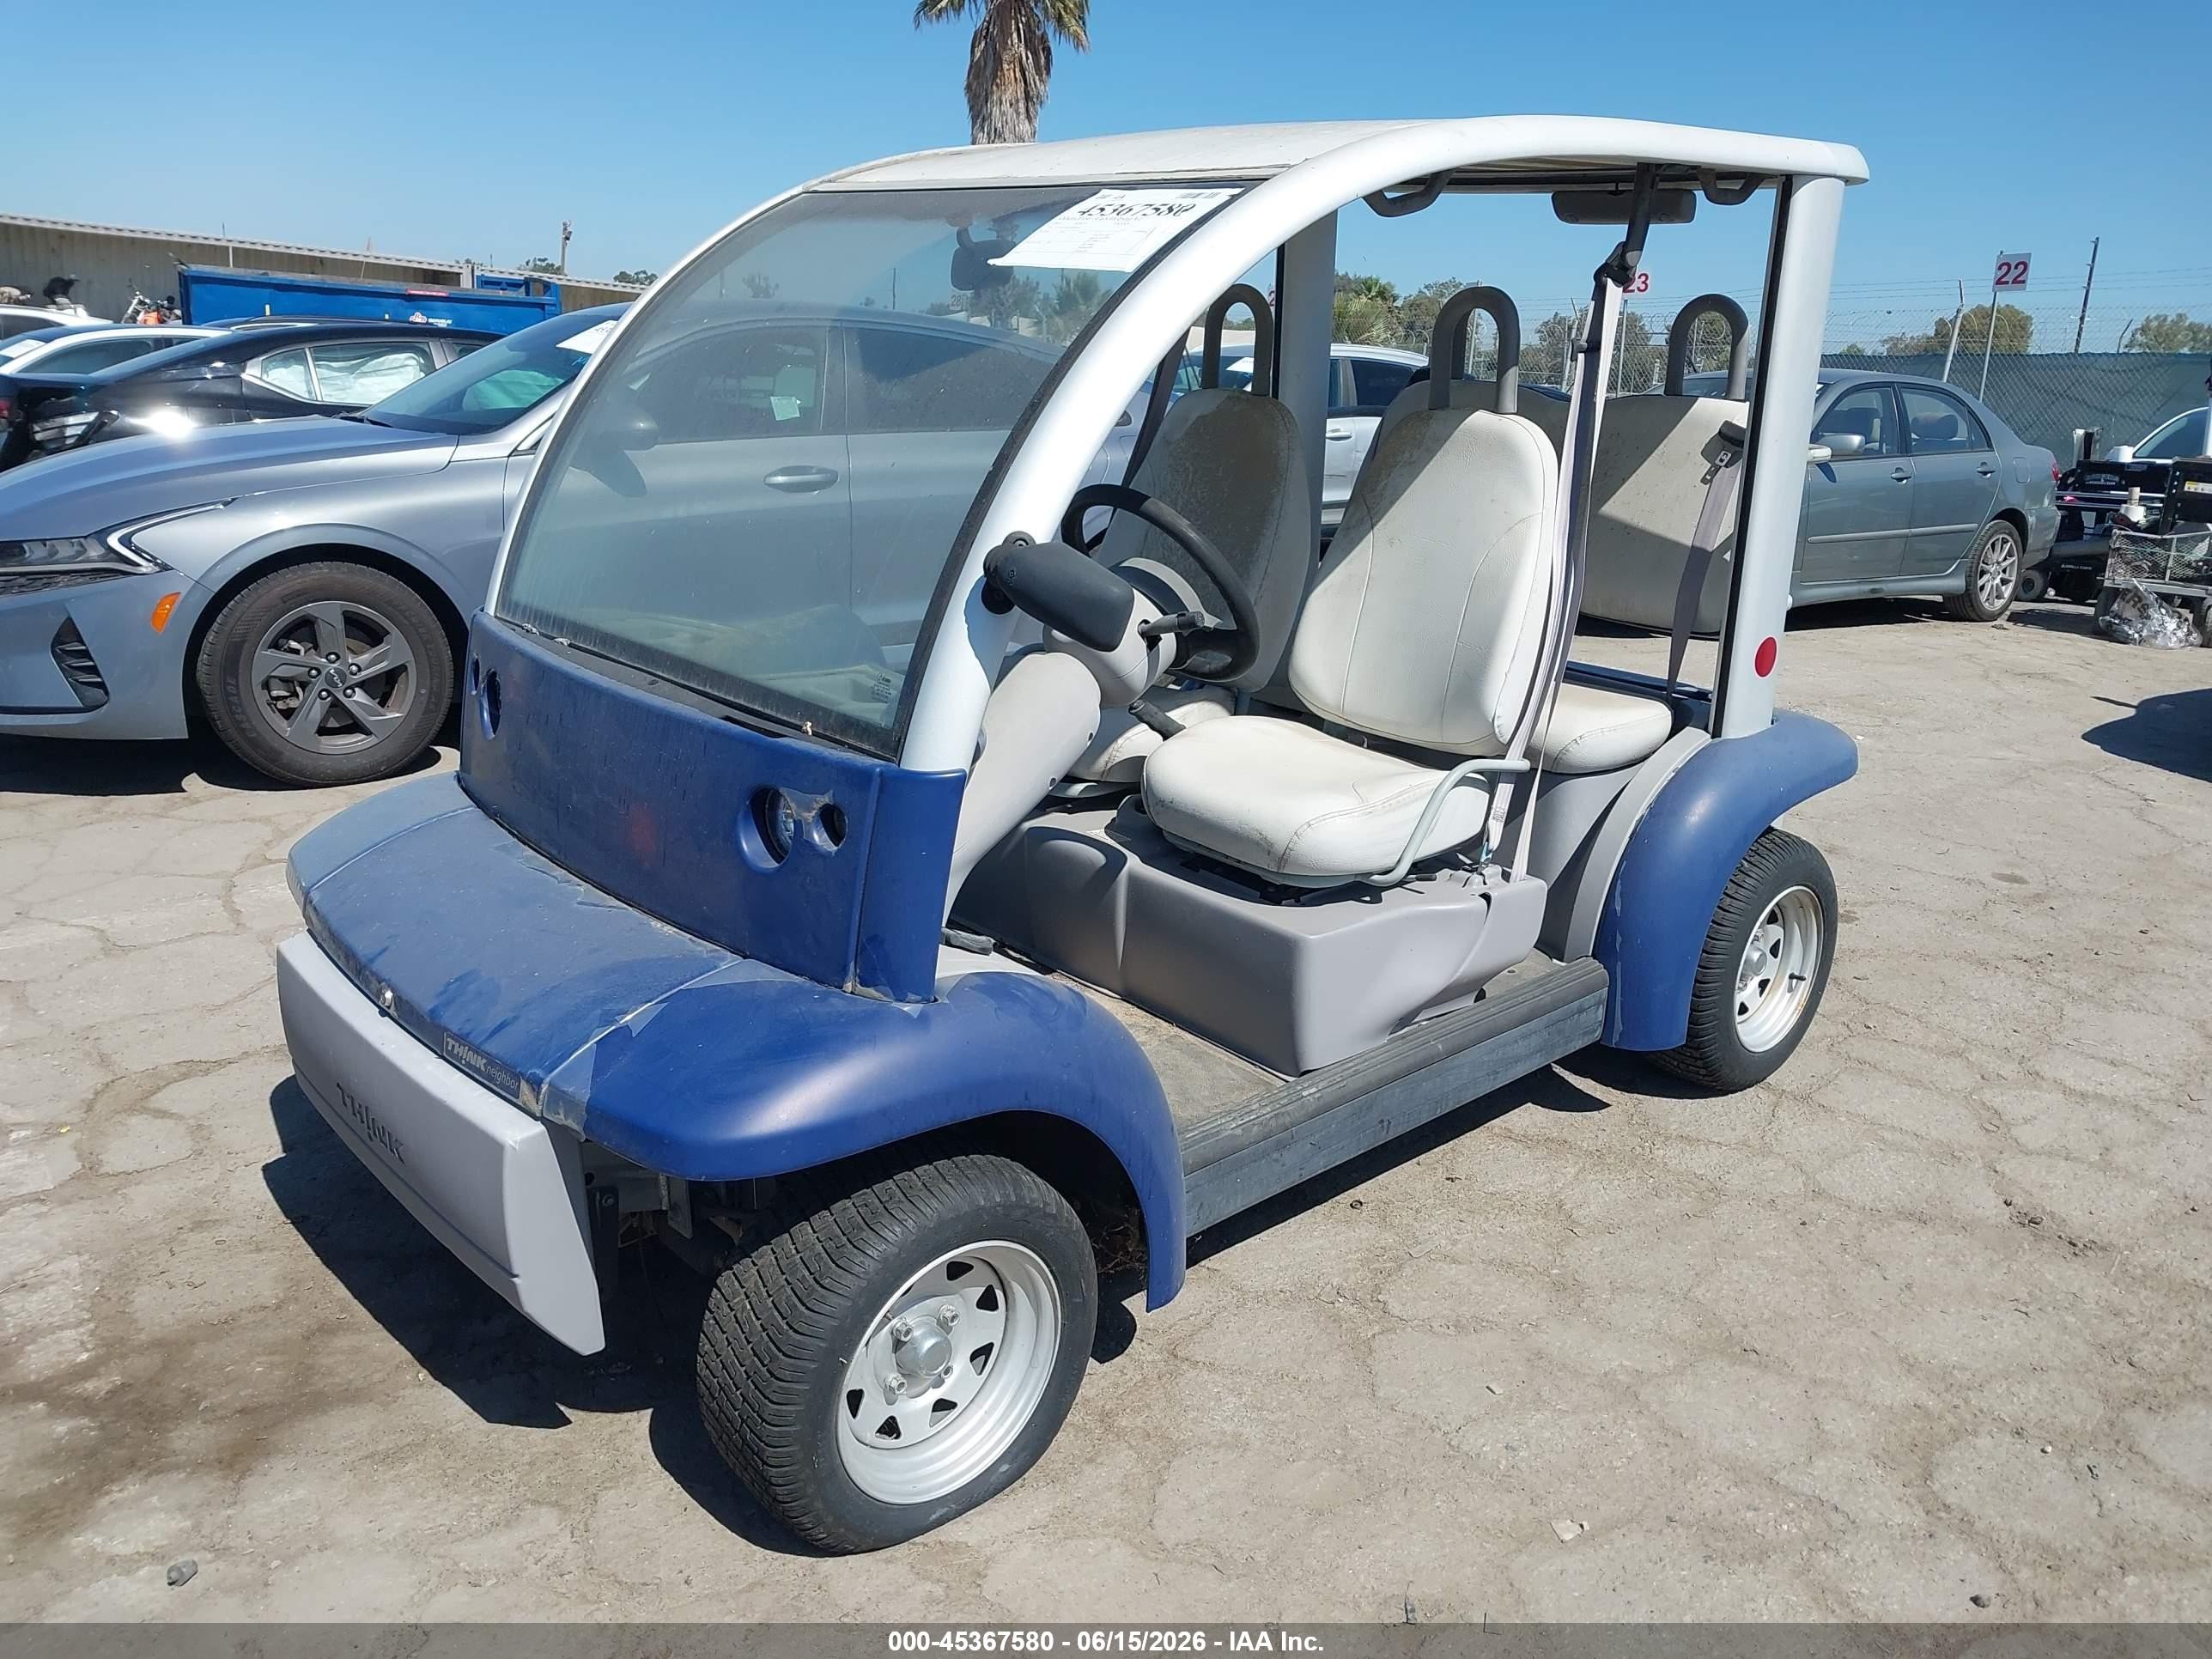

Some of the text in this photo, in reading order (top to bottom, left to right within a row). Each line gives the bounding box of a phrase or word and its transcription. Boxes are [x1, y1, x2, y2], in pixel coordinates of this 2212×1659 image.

[1078, 203, 1196, 217] 45367580
[1622, 272, 1650, 293] 23
[1995, 260, 2028, 285] 22
[486, 1066, 520, 1091] neighbor
